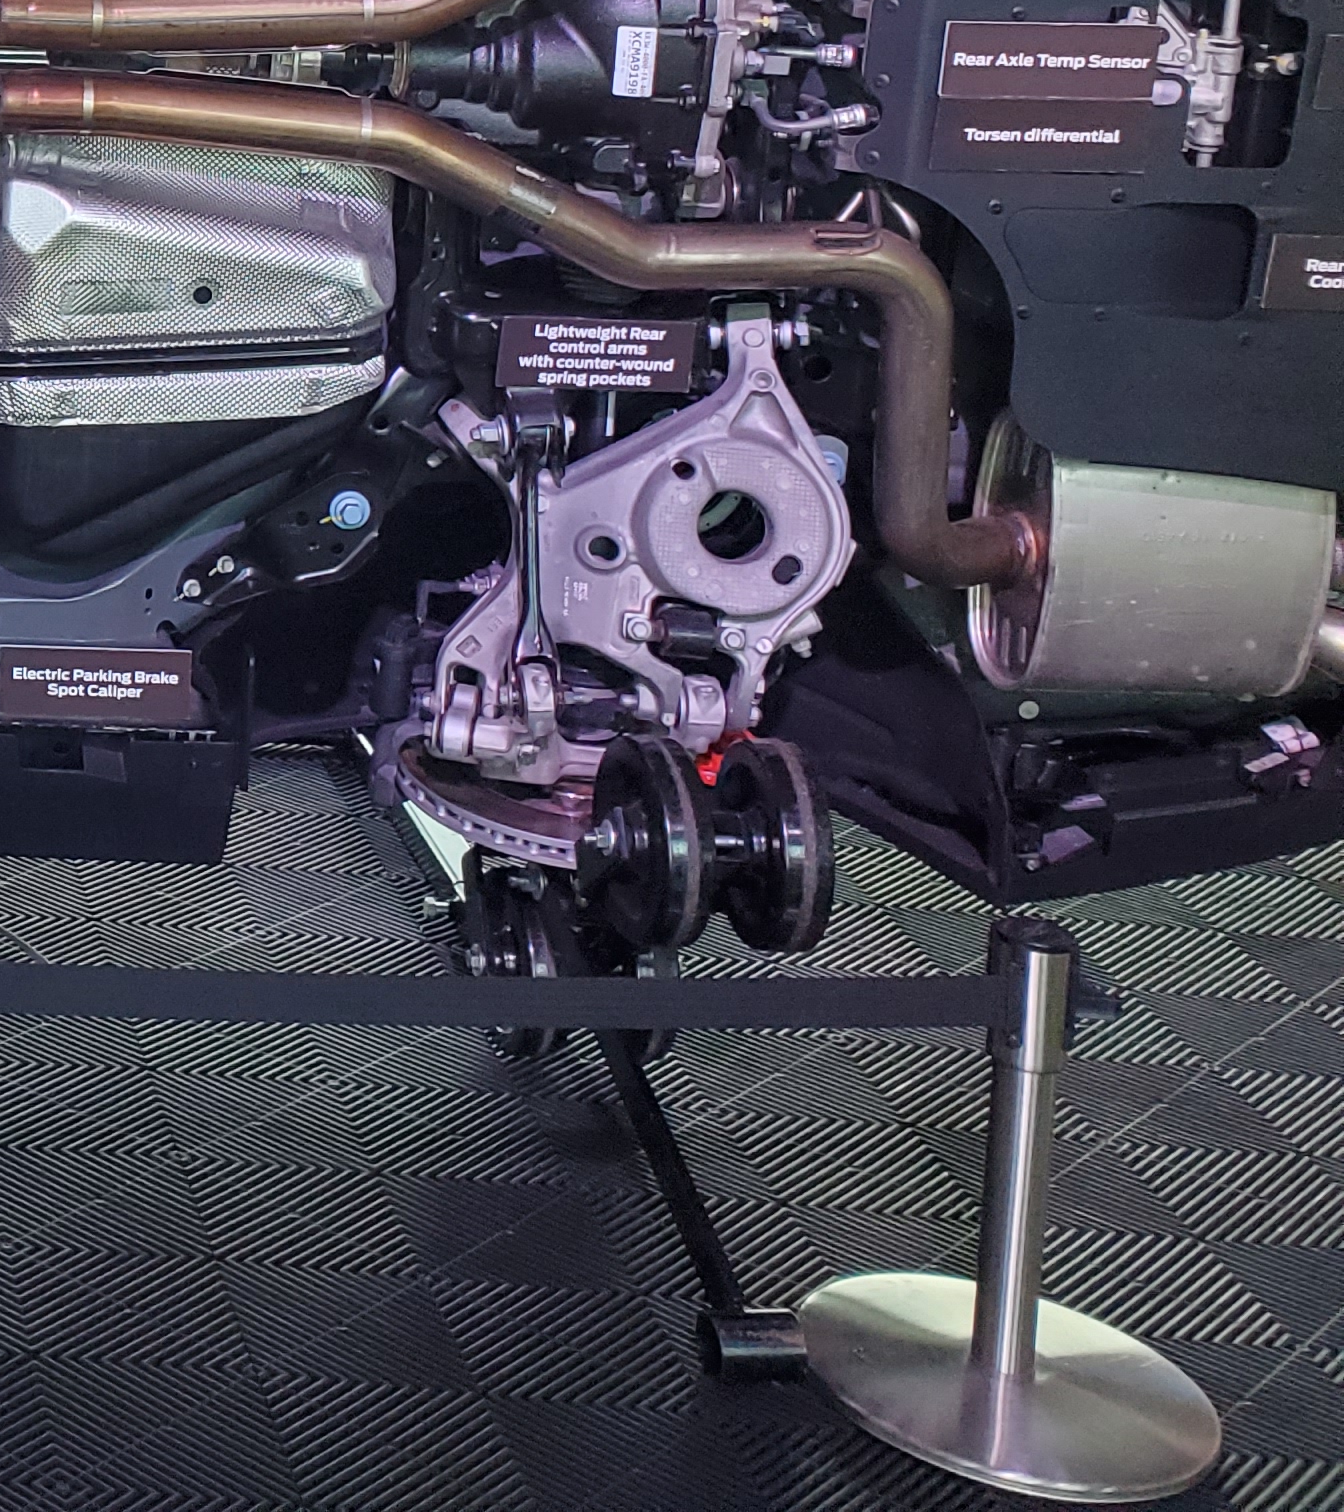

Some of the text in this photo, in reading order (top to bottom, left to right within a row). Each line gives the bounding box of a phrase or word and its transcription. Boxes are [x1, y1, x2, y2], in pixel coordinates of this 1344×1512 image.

[628, 32, 642, 94] XCMA9198
[953, 53, 1150, 70] Rear Axle Temp Sensor
[964, 128, 1120, 143] Torsen differential
[535, 324, 666, 342] Lightweight Rear
[549, 340, 647, 355] control arms
[519, 355, 674, 371] with counter-wound
[538, 371, 651, 386] spring pockets
[13, 667, 178, 685] Electric Parking Brake
[47, 683, 143, 700] Spot Caliper
